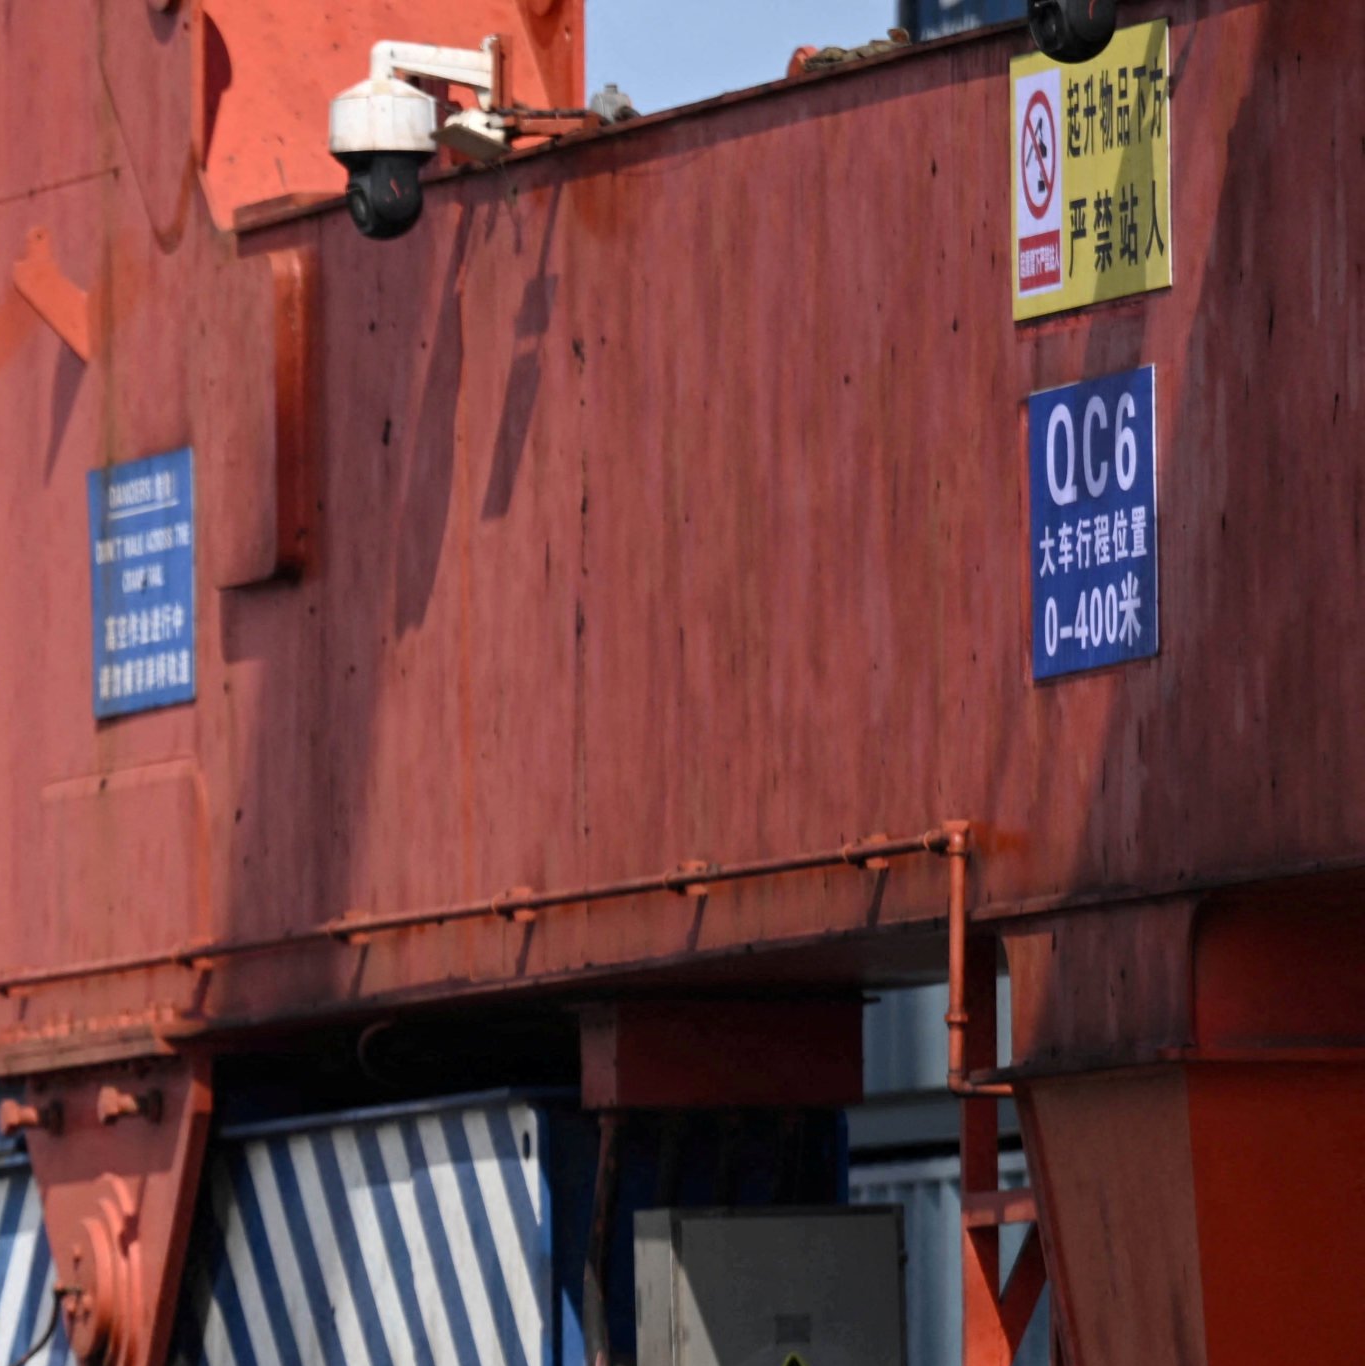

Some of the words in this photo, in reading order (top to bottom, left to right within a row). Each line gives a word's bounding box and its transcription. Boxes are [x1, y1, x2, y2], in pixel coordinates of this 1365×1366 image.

[1066, 57, 1164, 158] 起升物品下方
[1068, 180, 1165, 278] 严禁站人
[1046, 392, 1137, 505] QC6
[1038, 506, 1149, 579] 大车行程位置
[1044, 571, 1141, 658] 0-400米
